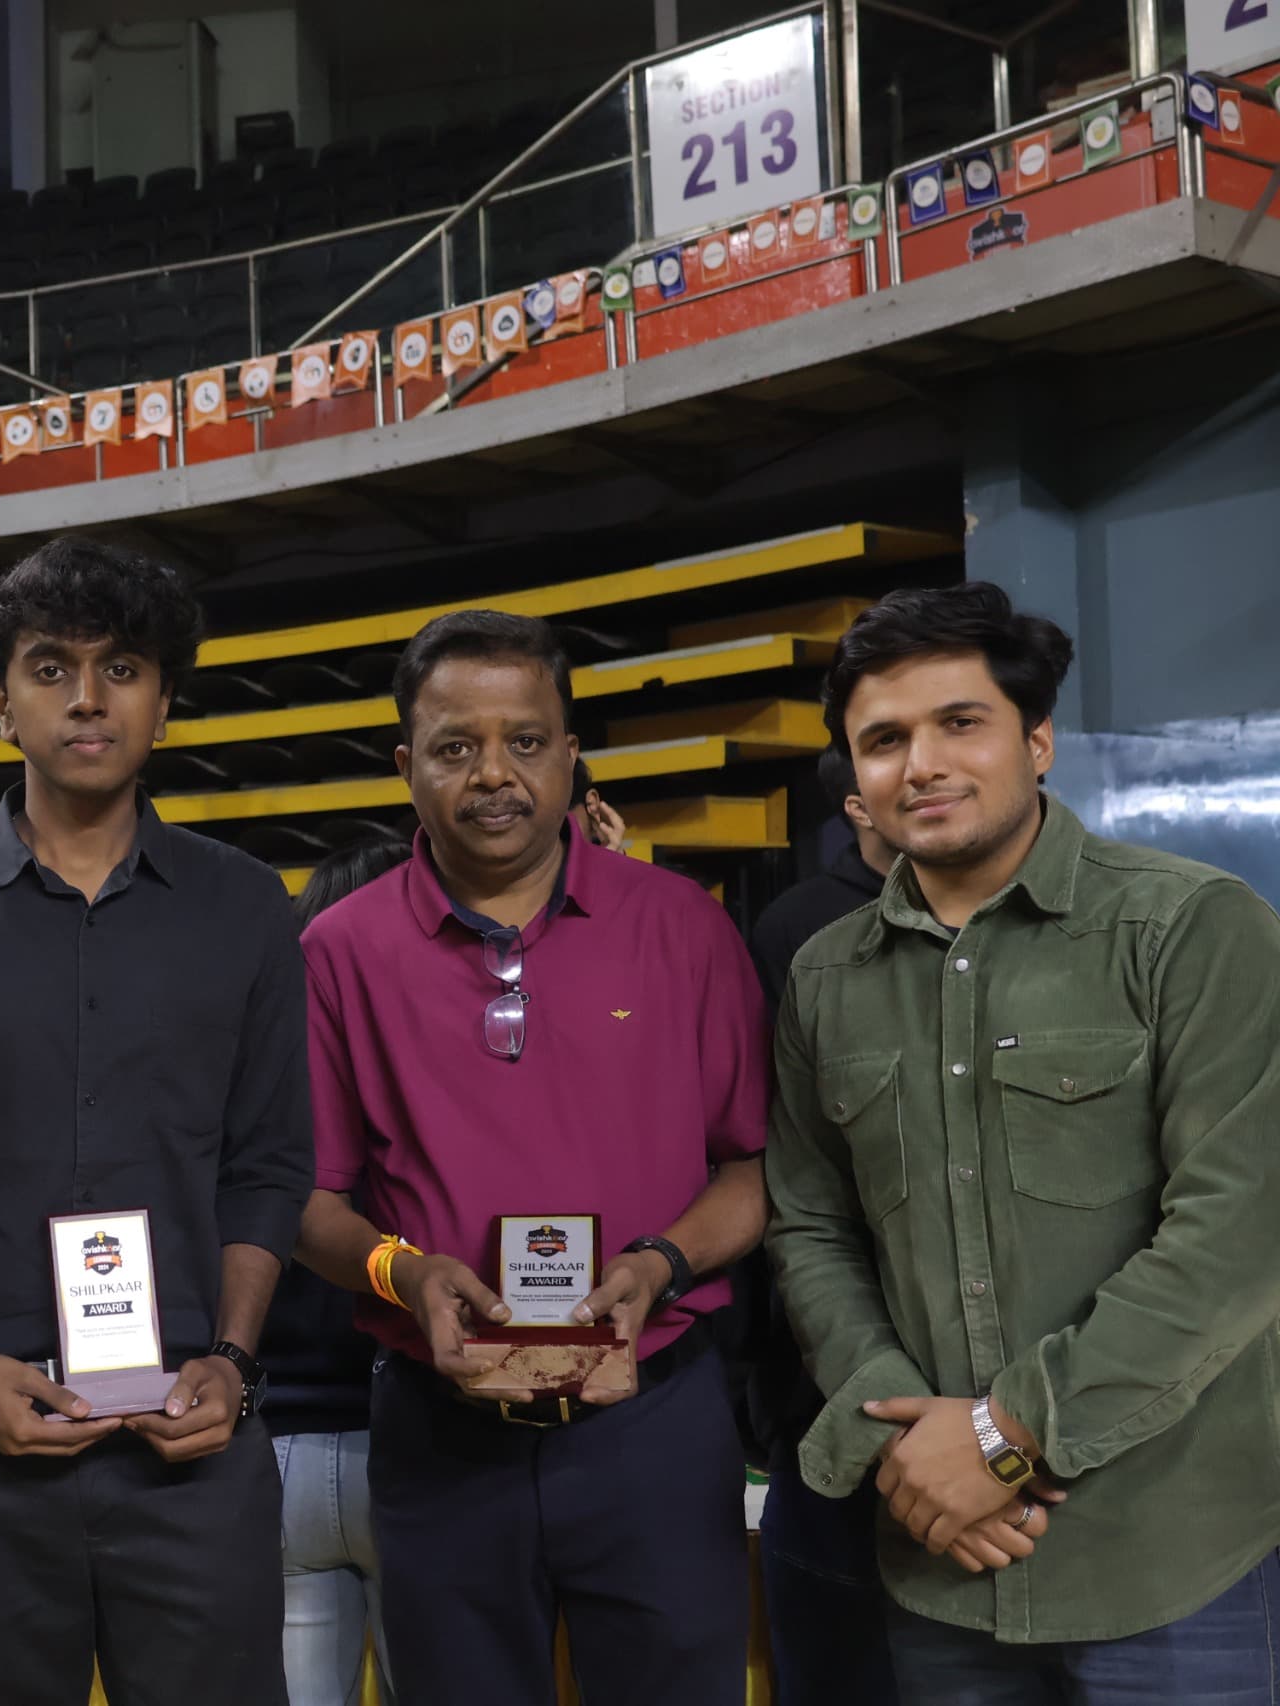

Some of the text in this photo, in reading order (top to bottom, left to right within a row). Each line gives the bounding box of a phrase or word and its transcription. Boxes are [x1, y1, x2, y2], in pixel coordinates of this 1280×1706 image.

[681, 72, 781, 123] SECTION
[681, 108, 797, 200] 213
[509, 1262, 585, 1272] SHILPKAAR
[69, 1280, 143, 1297] SHILPKAAR
[527, 1277, 567, 1286] AWARD
[89, 1302, 128, 1315] AWARD
